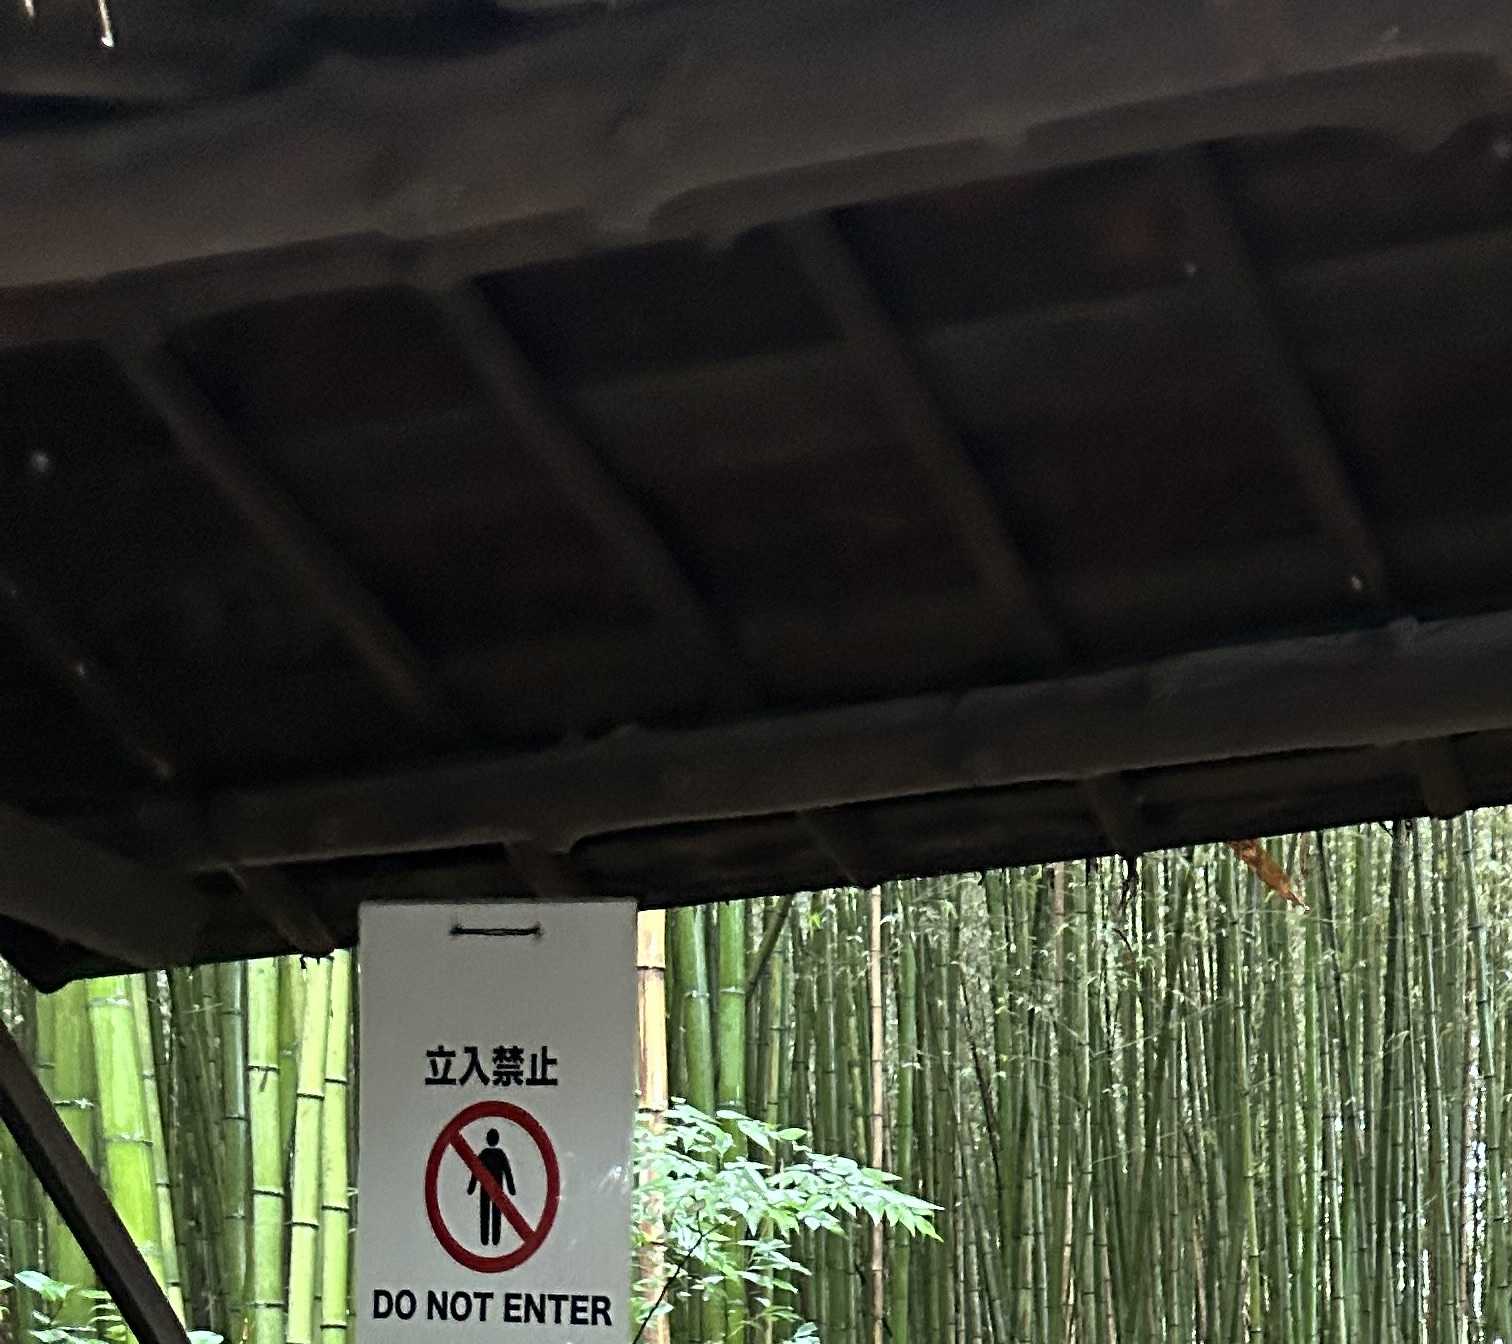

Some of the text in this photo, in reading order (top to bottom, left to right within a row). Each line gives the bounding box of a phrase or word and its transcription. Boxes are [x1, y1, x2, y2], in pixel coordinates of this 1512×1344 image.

[425, 1045, 558, 1086] 立入禁止
[372, 1289, 612, 1326] DO NOT ENTER
